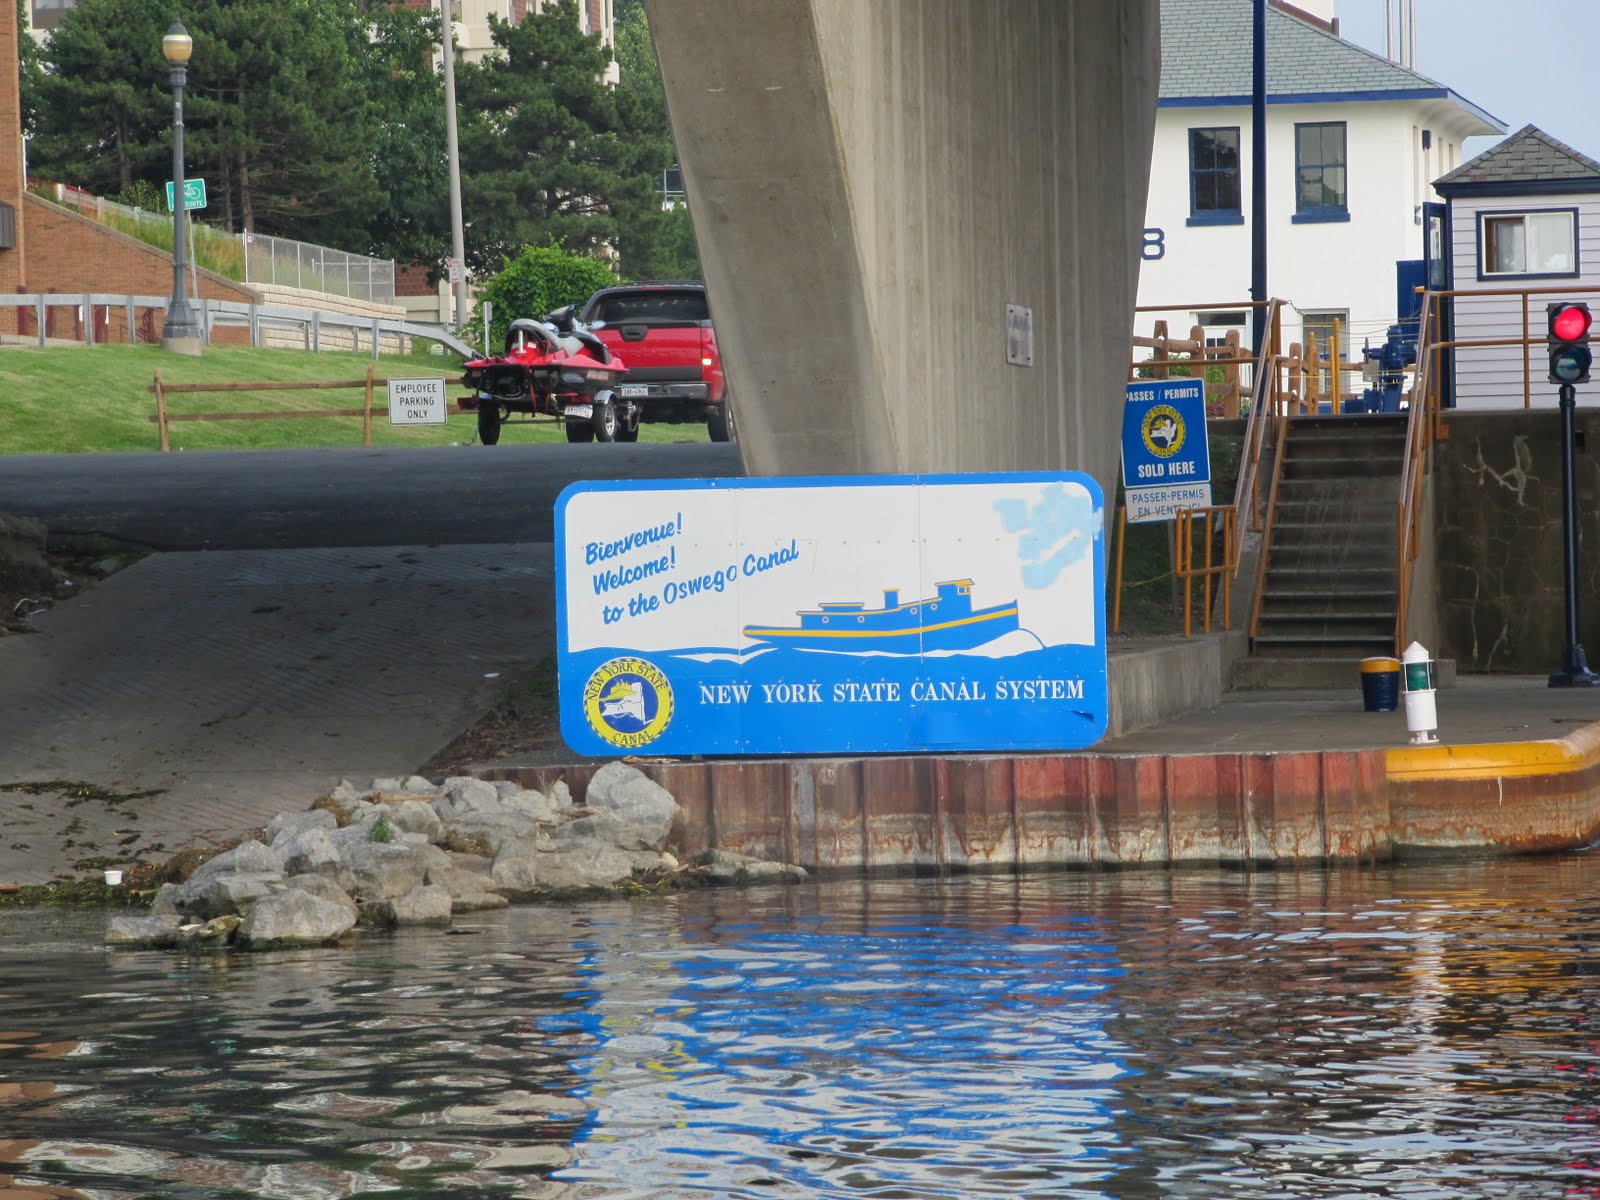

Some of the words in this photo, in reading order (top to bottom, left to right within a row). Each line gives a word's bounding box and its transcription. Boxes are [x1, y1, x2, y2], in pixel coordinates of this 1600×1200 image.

[395, 384, 437, 393] EMPLOYEE
[1164, 387, 1199, 399] PERMITS
[399, 397, 434, 406] PARKING
[407, 410, 428, 419] ONLY
[1138, 463, 1164, 478] SOLD
[1168, 461, 1195, 476] HERE
[1132, 489, 1204, 504] PASSER-PERMIS
[1138, 506, 1150, 517] EN
[585, 512, 682, 565] Bienvenue!
[593, 546, 676, 595] Welcome!
[602, 605, 625, 624] to
[628, 592, 660, 617] the
[663, 565, 737, 604] Oswego
[742, 539, 799, 577] Canal
[588, 678, 605, 701] NEW
[605, 662, 634, 677] YORK
[637, 664, 665, 692] STATE
[700, 684, 752, 704] NEW
[761, 683, 823, 703] YORK
[833, 682, 900, 703] STATE
[910, 681, 986, 701] CANAL
[995, 679, 1085, 700] SYSTEM
[613, 731, 654, 745] CANAL
